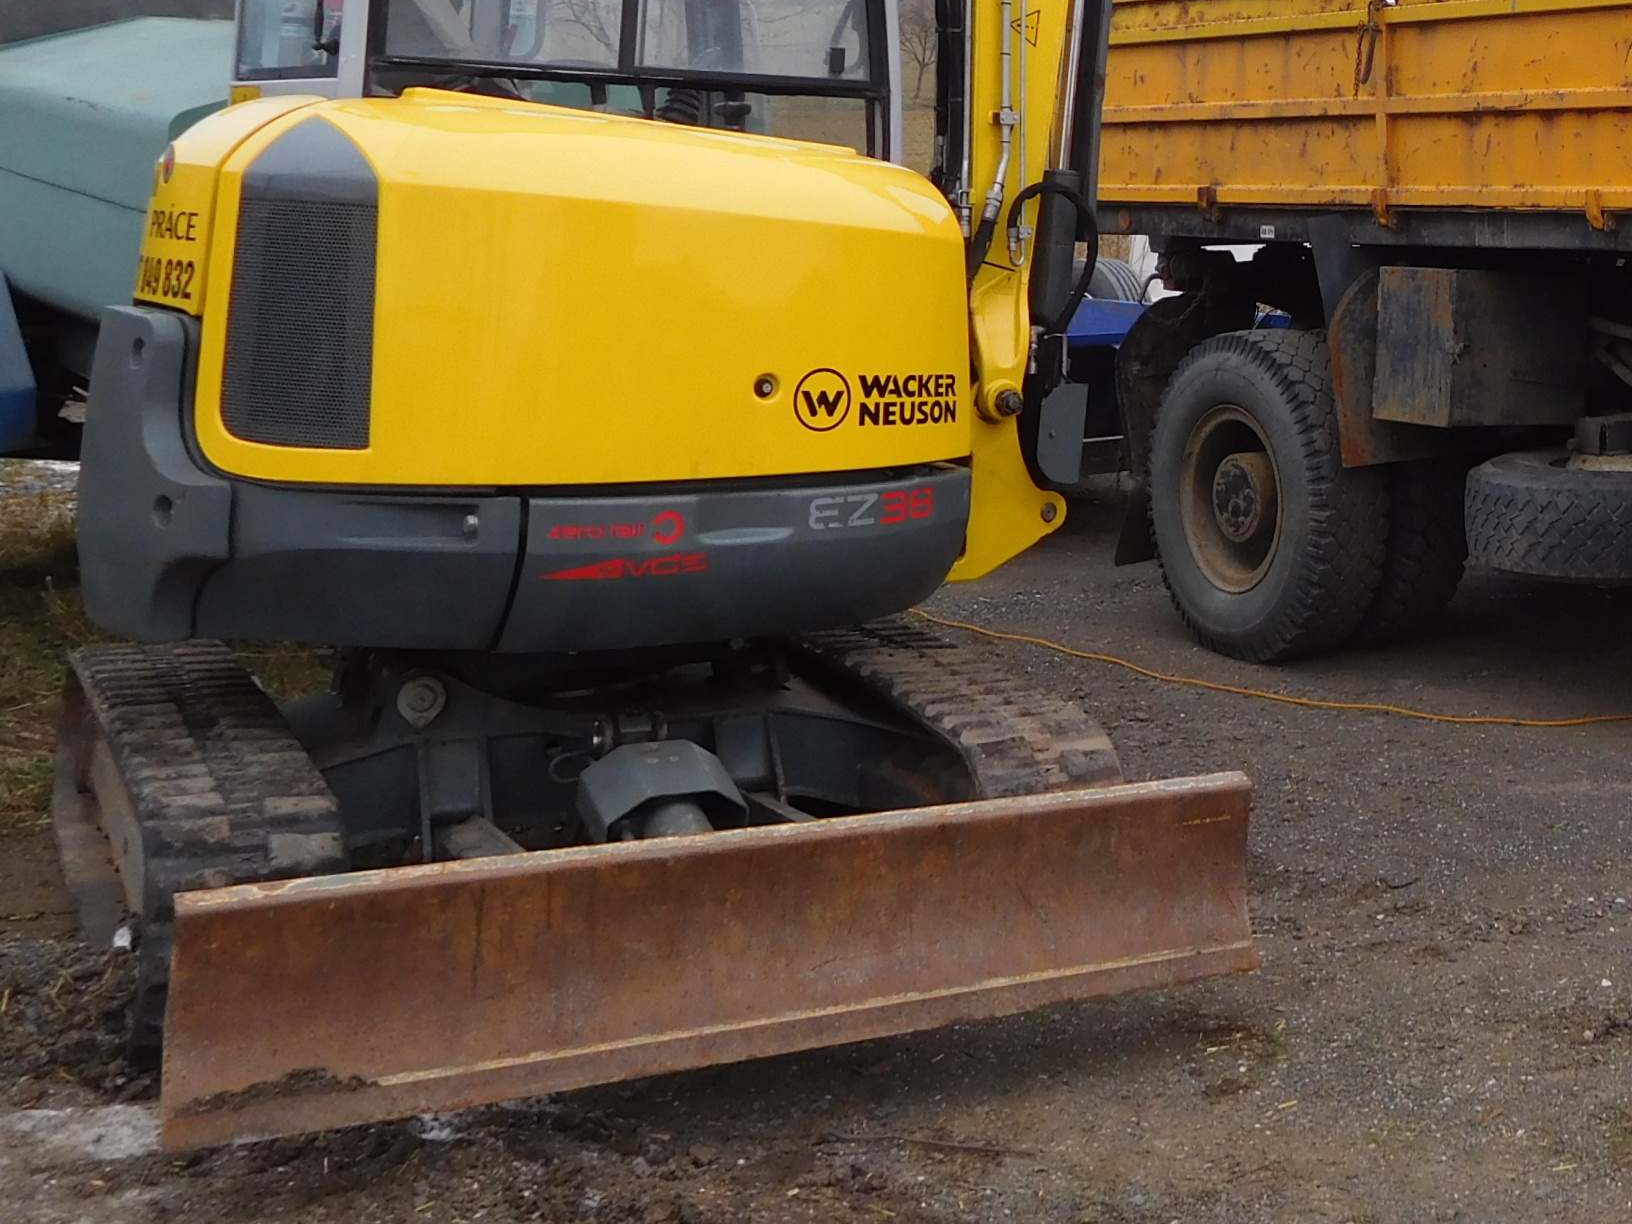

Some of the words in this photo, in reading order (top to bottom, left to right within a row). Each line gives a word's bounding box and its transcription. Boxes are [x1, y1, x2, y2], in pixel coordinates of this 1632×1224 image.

[149, 203, 199, 242] PRÁCE
[162, 259, 195, 300] 832
[857, 374, 957, 398] WACKER
[858, 400, 957, 426] NEUSON
[547, 525, 605, 539] zero
